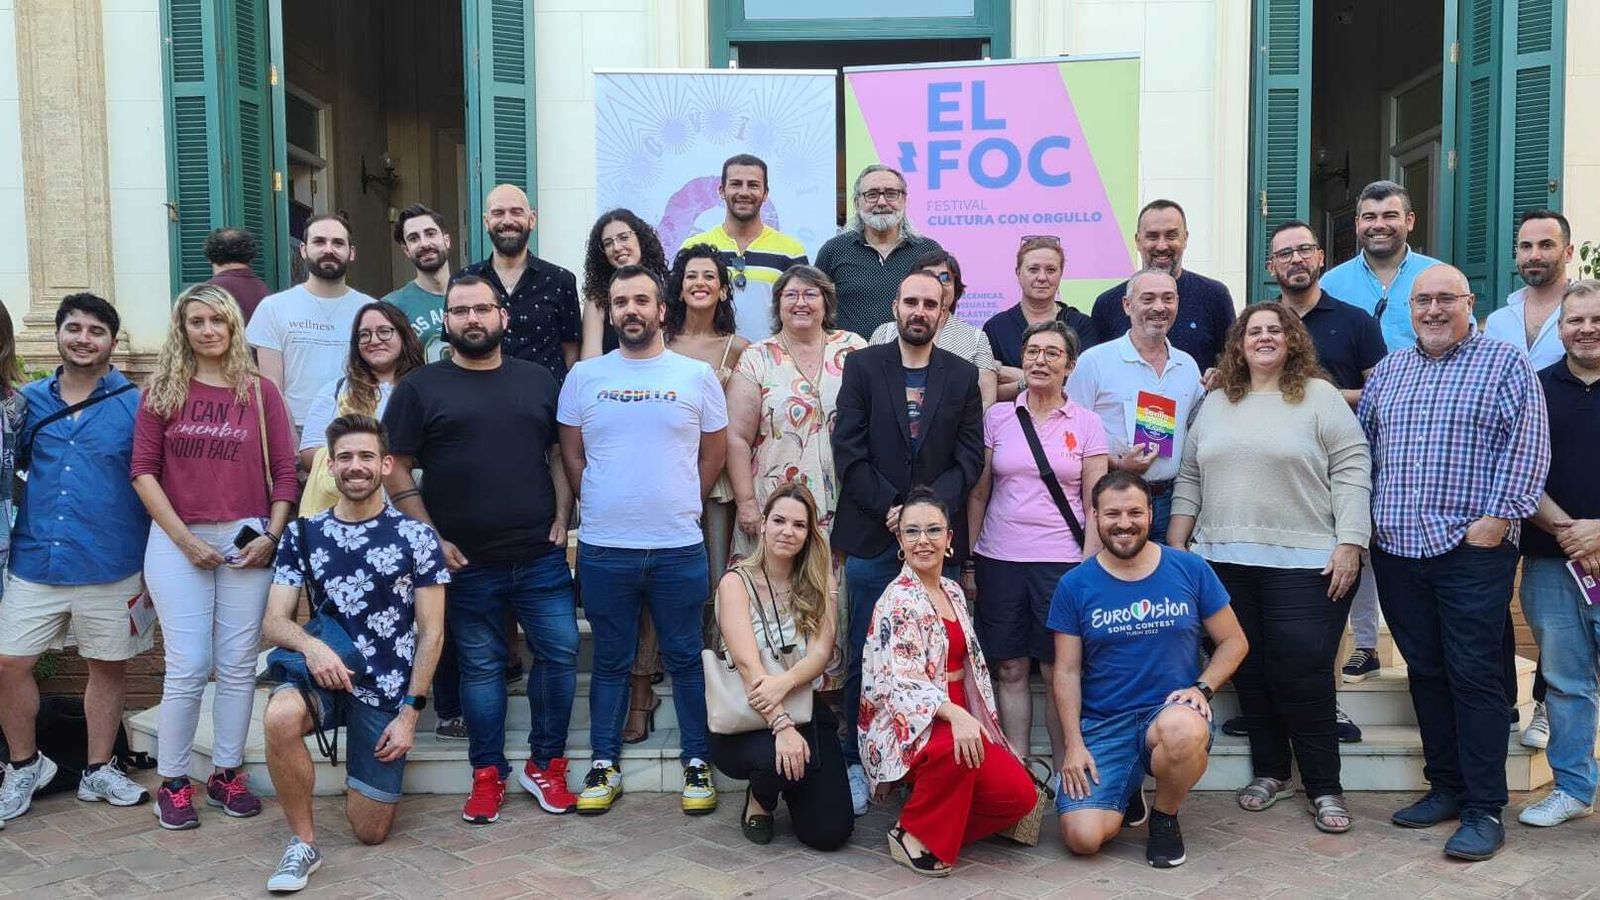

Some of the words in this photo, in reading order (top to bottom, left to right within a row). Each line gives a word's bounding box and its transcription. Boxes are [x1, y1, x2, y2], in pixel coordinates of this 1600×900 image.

[928, 80, 1006, 132] EL
[928, 135, 1072, 190] FOC
[927, 199, 988, 212] FESTIVAL
[928, 215, 994, 226] CULTURA
[998, 214, 1030, 225] CON
[1032, 211, 1102, 223] ORGULLO
[288, 319, 335, 331] wellness
[597, 390, 677, 403] ORGULLO
[207, 439, 242, 462] FACE
[1107, 624, 1132, 634] SONG
[1135, 619, 1175, 630] CONTEST
